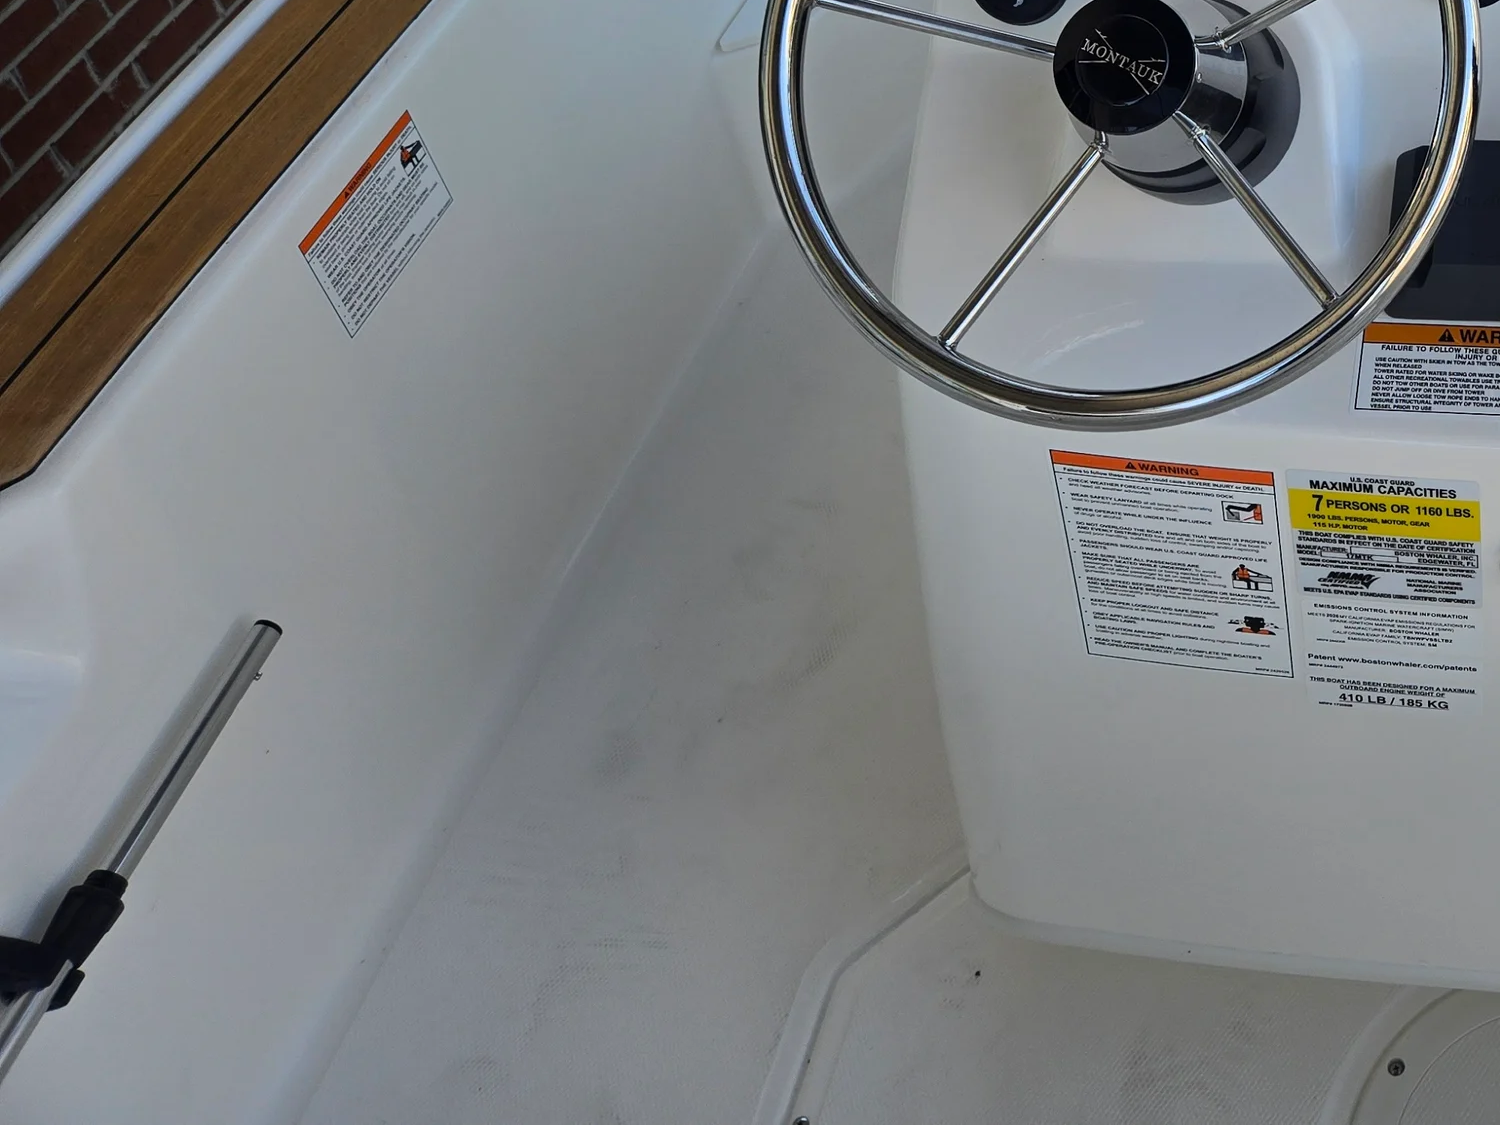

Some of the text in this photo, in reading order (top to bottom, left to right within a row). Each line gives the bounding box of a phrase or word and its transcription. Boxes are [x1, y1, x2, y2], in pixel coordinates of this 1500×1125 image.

[1081, 38, 1163, 85] MONTAUK
[1138, 463, 1198, 476] WARNING
[1309, 479, 1456, 499] MAXIMUM CAPACITIES
[1312, 494, 1323, 511] 7
[1326, 499, 1474, 518] PERSONS OR 1160 LBS.
[1426, 545, 1475, 553] CERTIFICATION
[1339, 693, 1363, 703] 410
[1367, 695, 1386, 704] LB
[1400, 698, 1422, 707] 185
[1427, 700, 1448, 709] KG
